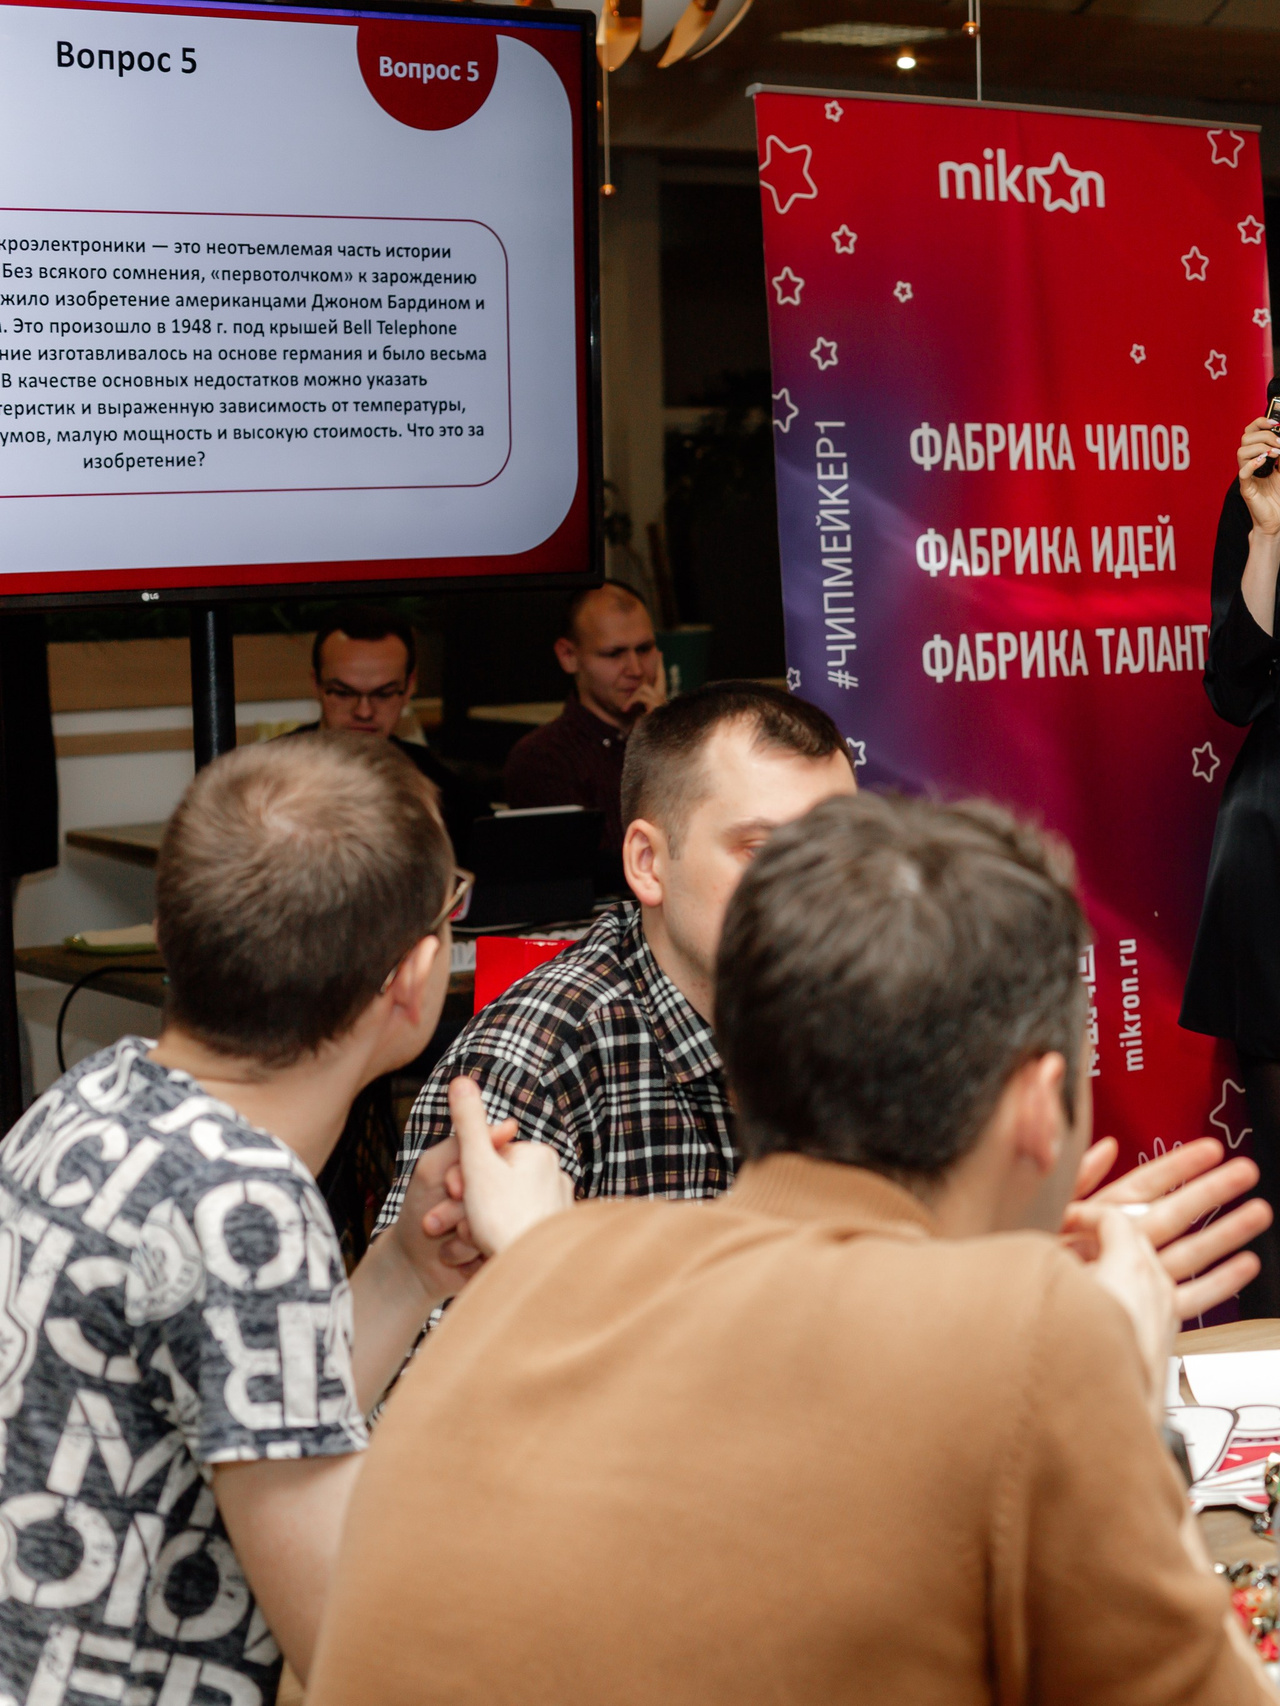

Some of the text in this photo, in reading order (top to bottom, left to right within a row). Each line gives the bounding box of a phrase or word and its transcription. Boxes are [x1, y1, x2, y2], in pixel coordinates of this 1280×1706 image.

[57, 40, 196, 77] Вопрос 5
[379, 56, 478, 83] Вопрос 5
[174, 242, 200, 253] это
[206, 243, 332, 255] неотъемлемая
[338, 245, 380, 256] часть
[386, 246, 450, 261] истории
[2, 263, 476, 286] Без всякого сомнения, «первотолчком» к зарождению
[0, 290, 484, 312] жило изобретение американцами Джоном Бардином и
[13, 318, 43, 333] Это
[50, 321, 150, 336] произошло
[157, 322, 165, 333] в
[172, 318, 211, 333] 1948
[217, 322, 226, 333] г.
[233, 323, 264, 337] под
[270, 319, 337, 337] крышей
[344, 319, 371, 334] Bell
[376, 319, 456, 338] Telephone
[38, 349, 187, 360] изготавливалось
[193, 349, 212, 360] на
[218, 349, 276, 360] основе
[283, 349, 362, 363] германия
[368, 349, 376, 359] и
[383, 345, 424, 360] было
[430, 349, 486, 360] весьма
[2, 373, 427, 389] В качестве основных недостатков можно указать
[81, 403, 91, 414] и
[98, 402, 214, 417] выраженную
[219, 401, 326, 413] зависимость
[332, 401, 348, 412] от
[353, 400, 465, 414] температуры,
[57, 430, 117, 445] малую
[123, 429, 212, 443] мощность
[218, 428, 226, 439] и
[233, 427, 308, 442] высокую
[313, 426, 401, 438] стоимость.
[407, 423, 434, 436] Что
[439, 425, 463, 436] это
[468, 425, 483, 436] за
[909, 421, 1192, 472] ФАБРИКА ЧИПОВ
[83, 451, 204, 471] изобретение?
[815, 420, 860, 689] #ЧИПМЕЙКЕР1
[915, 515, 1177, 579] ФАБРИКА ИДЕЙ
[921, 624, 1210, 683] ФАБРИКА ТАЛАНТ
[1118, 938, 1144, 1072] mikron.ru
